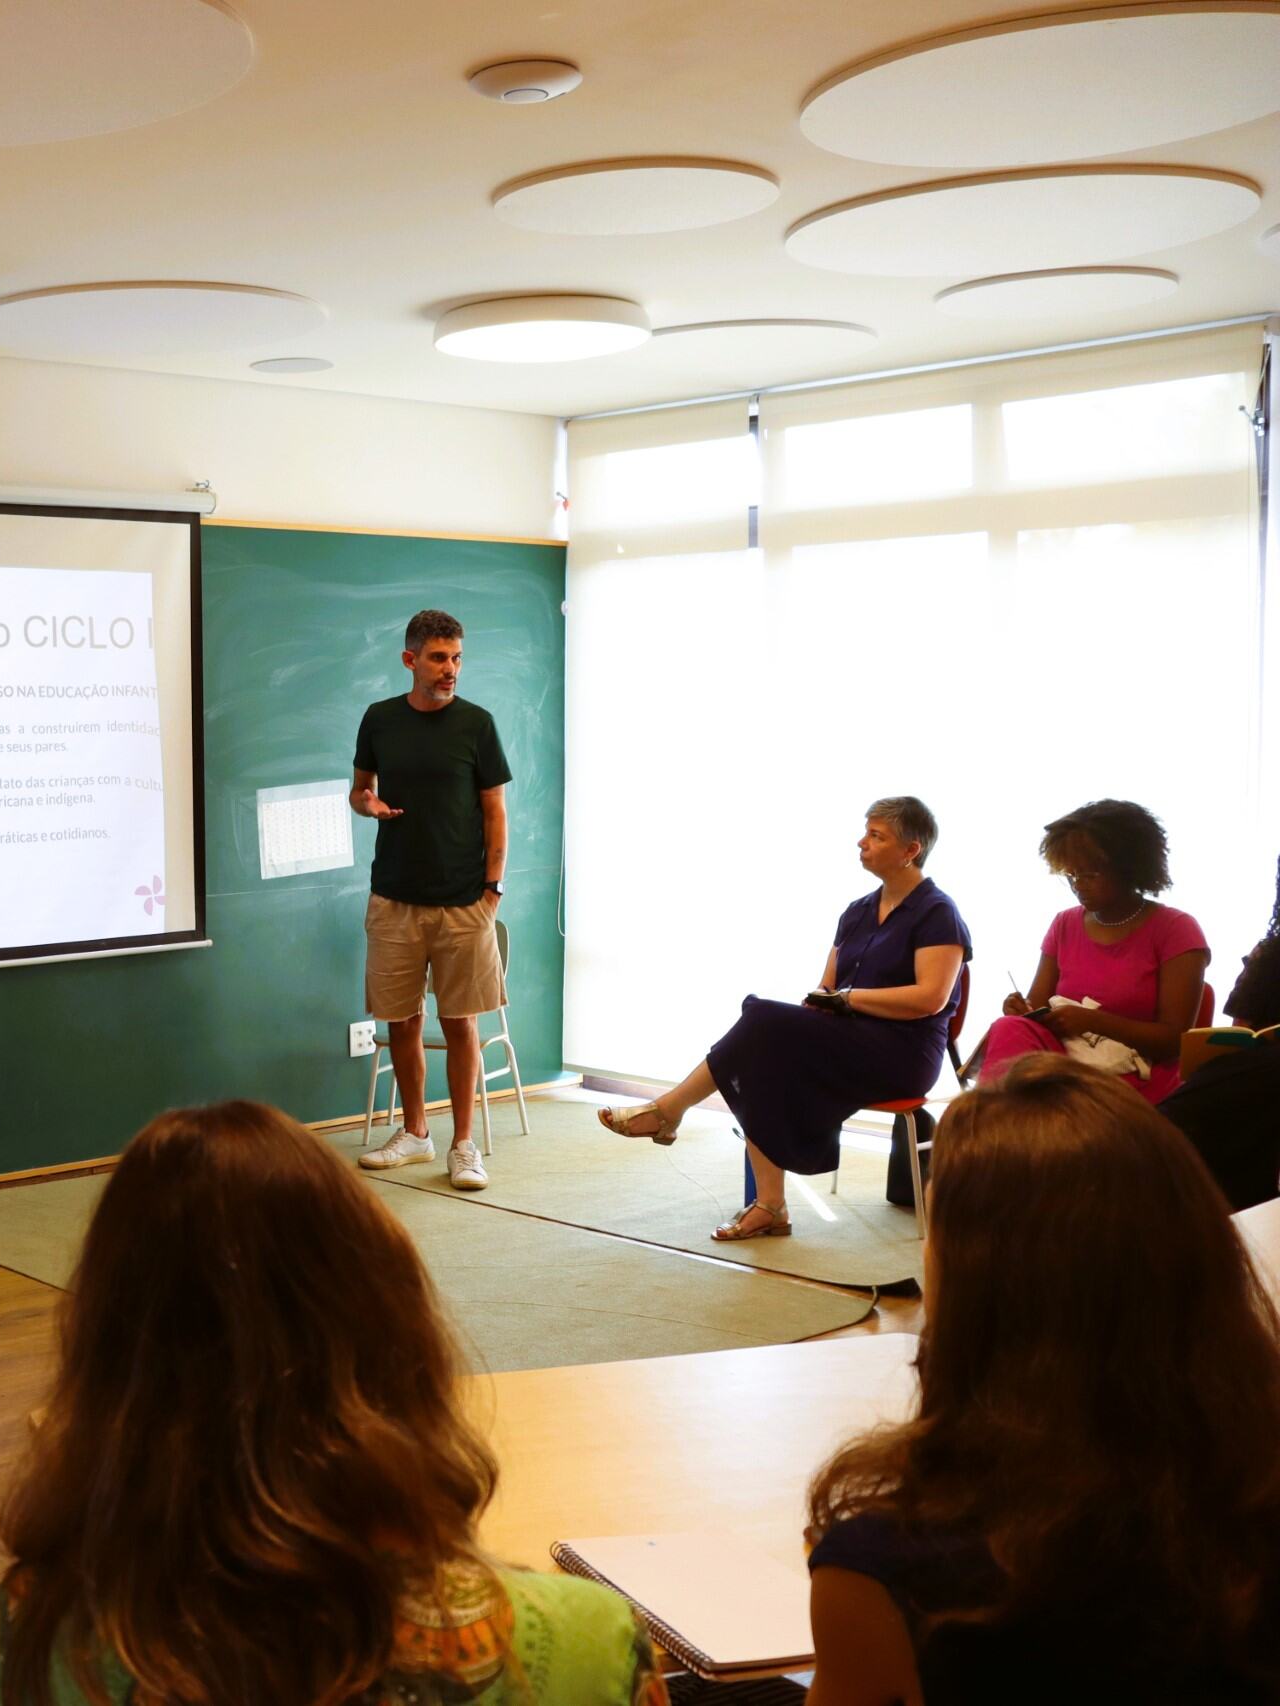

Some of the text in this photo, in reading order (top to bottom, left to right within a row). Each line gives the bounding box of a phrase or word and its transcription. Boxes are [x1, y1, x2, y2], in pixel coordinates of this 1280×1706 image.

[23, 615, 135, 649] CICLO
[16, 685, 36, 699] NA
[38, 684, 110, 701] EDUCAÇÃO
[18, 725, 25, 735] a
[31, 721, 101, 735] construirem
[6, 743, 32, 753] seus
[25, 776, 46, 789] das
[48, 775, 95, 789] crianças
[97, 775, 121, 785] com
[123, 776, 131, 787] a
[36, 796, 44, 806] e
[40, 832, 48, 843] e
